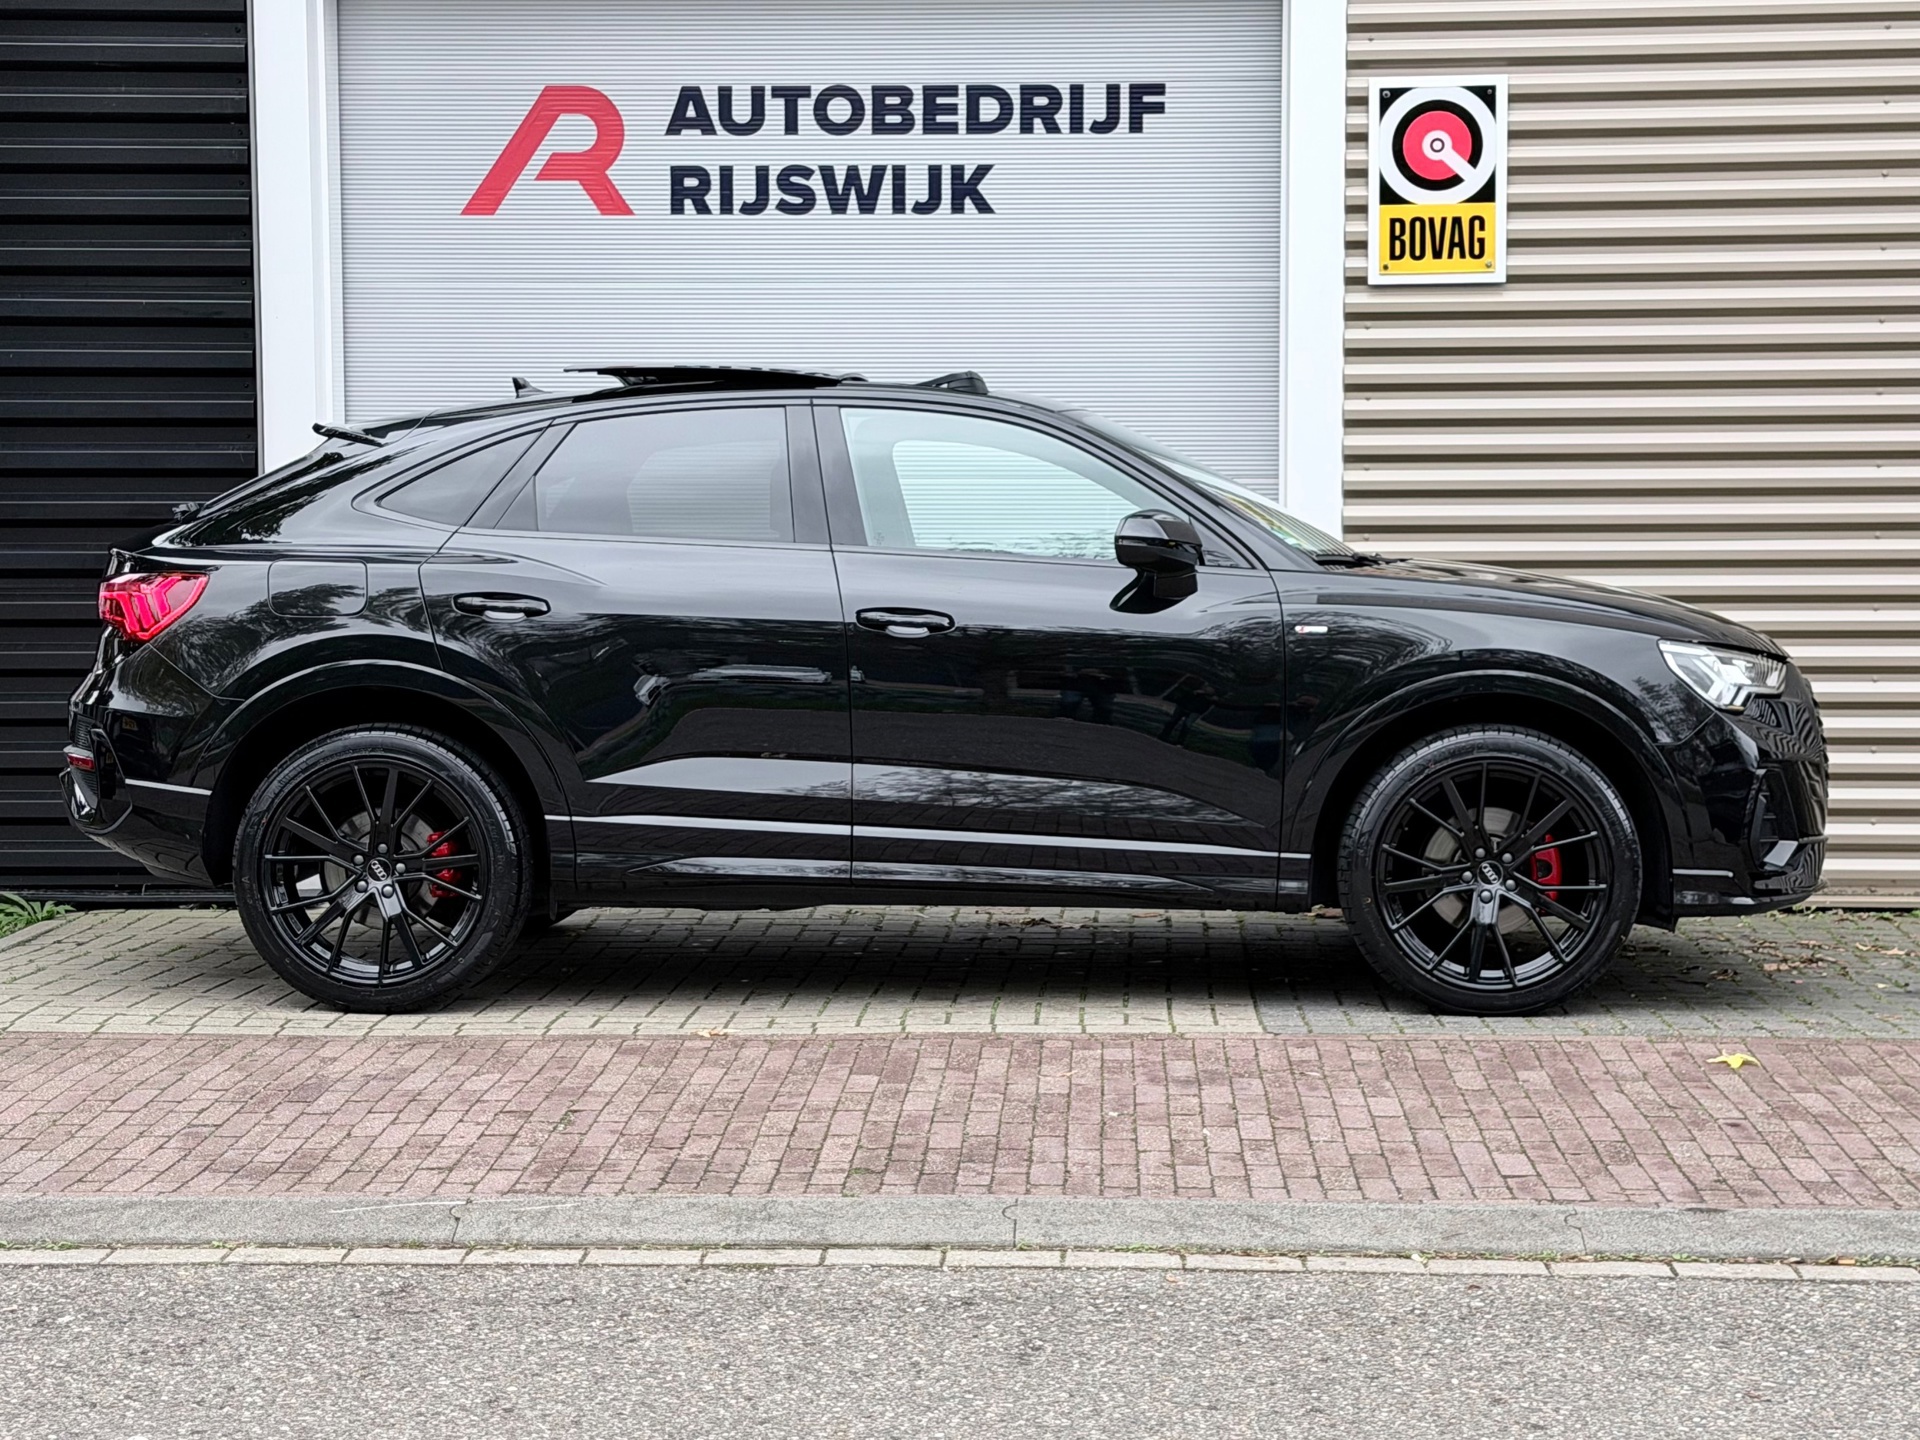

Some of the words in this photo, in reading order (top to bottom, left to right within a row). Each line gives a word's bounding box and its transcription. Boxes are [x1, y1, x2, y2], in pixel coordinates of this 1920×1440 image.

[664, 83, 1166, 137] AUTOBEDRIJF
[669, 164, 995, 216] RIJSWIJK
[1388, 215, 1486, 261] BOVAG
